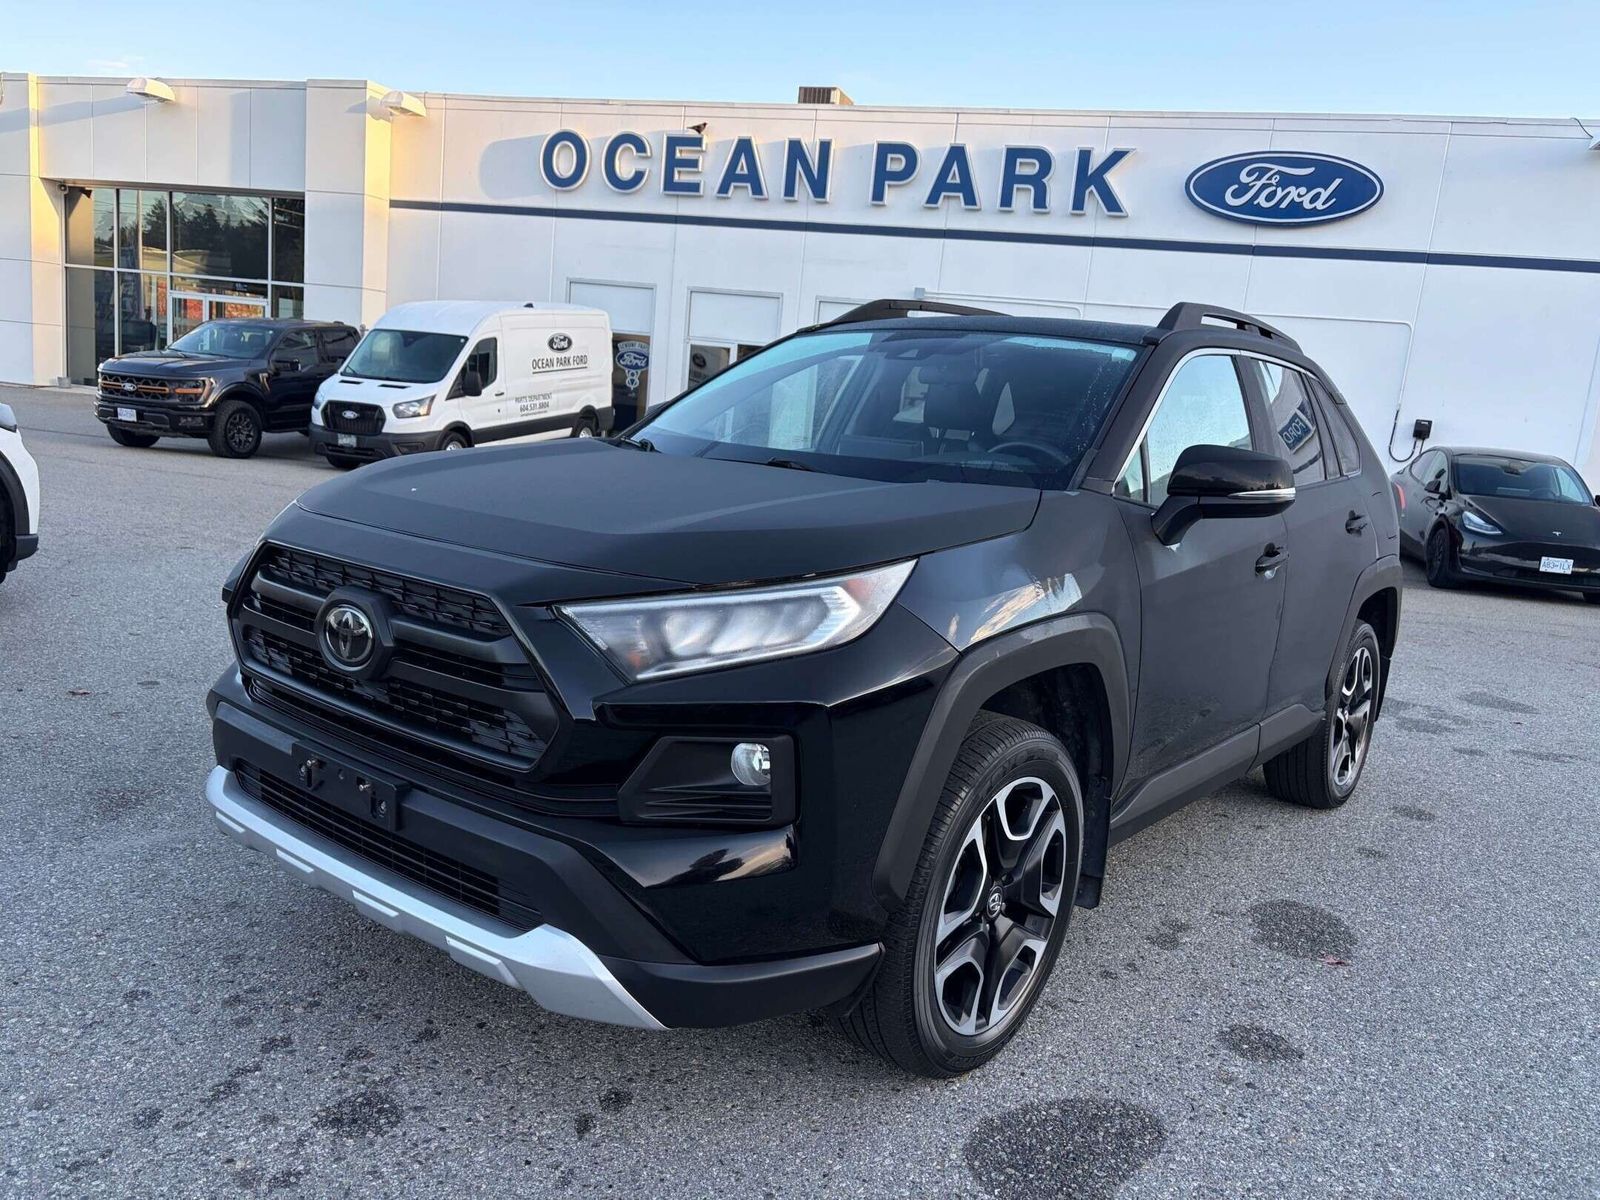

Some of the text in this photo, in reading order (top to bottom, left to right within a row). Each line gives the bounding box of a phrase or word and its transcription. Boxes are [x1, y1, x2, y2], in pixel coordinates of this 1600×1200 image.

[540, 128, 1136, 218] OCEAN PARK
[1225, 162, 1342, 212] Ford
[531, 354, 588, 370] OCEAN PARK FORD
[620, 352, 648, 367] Ford
